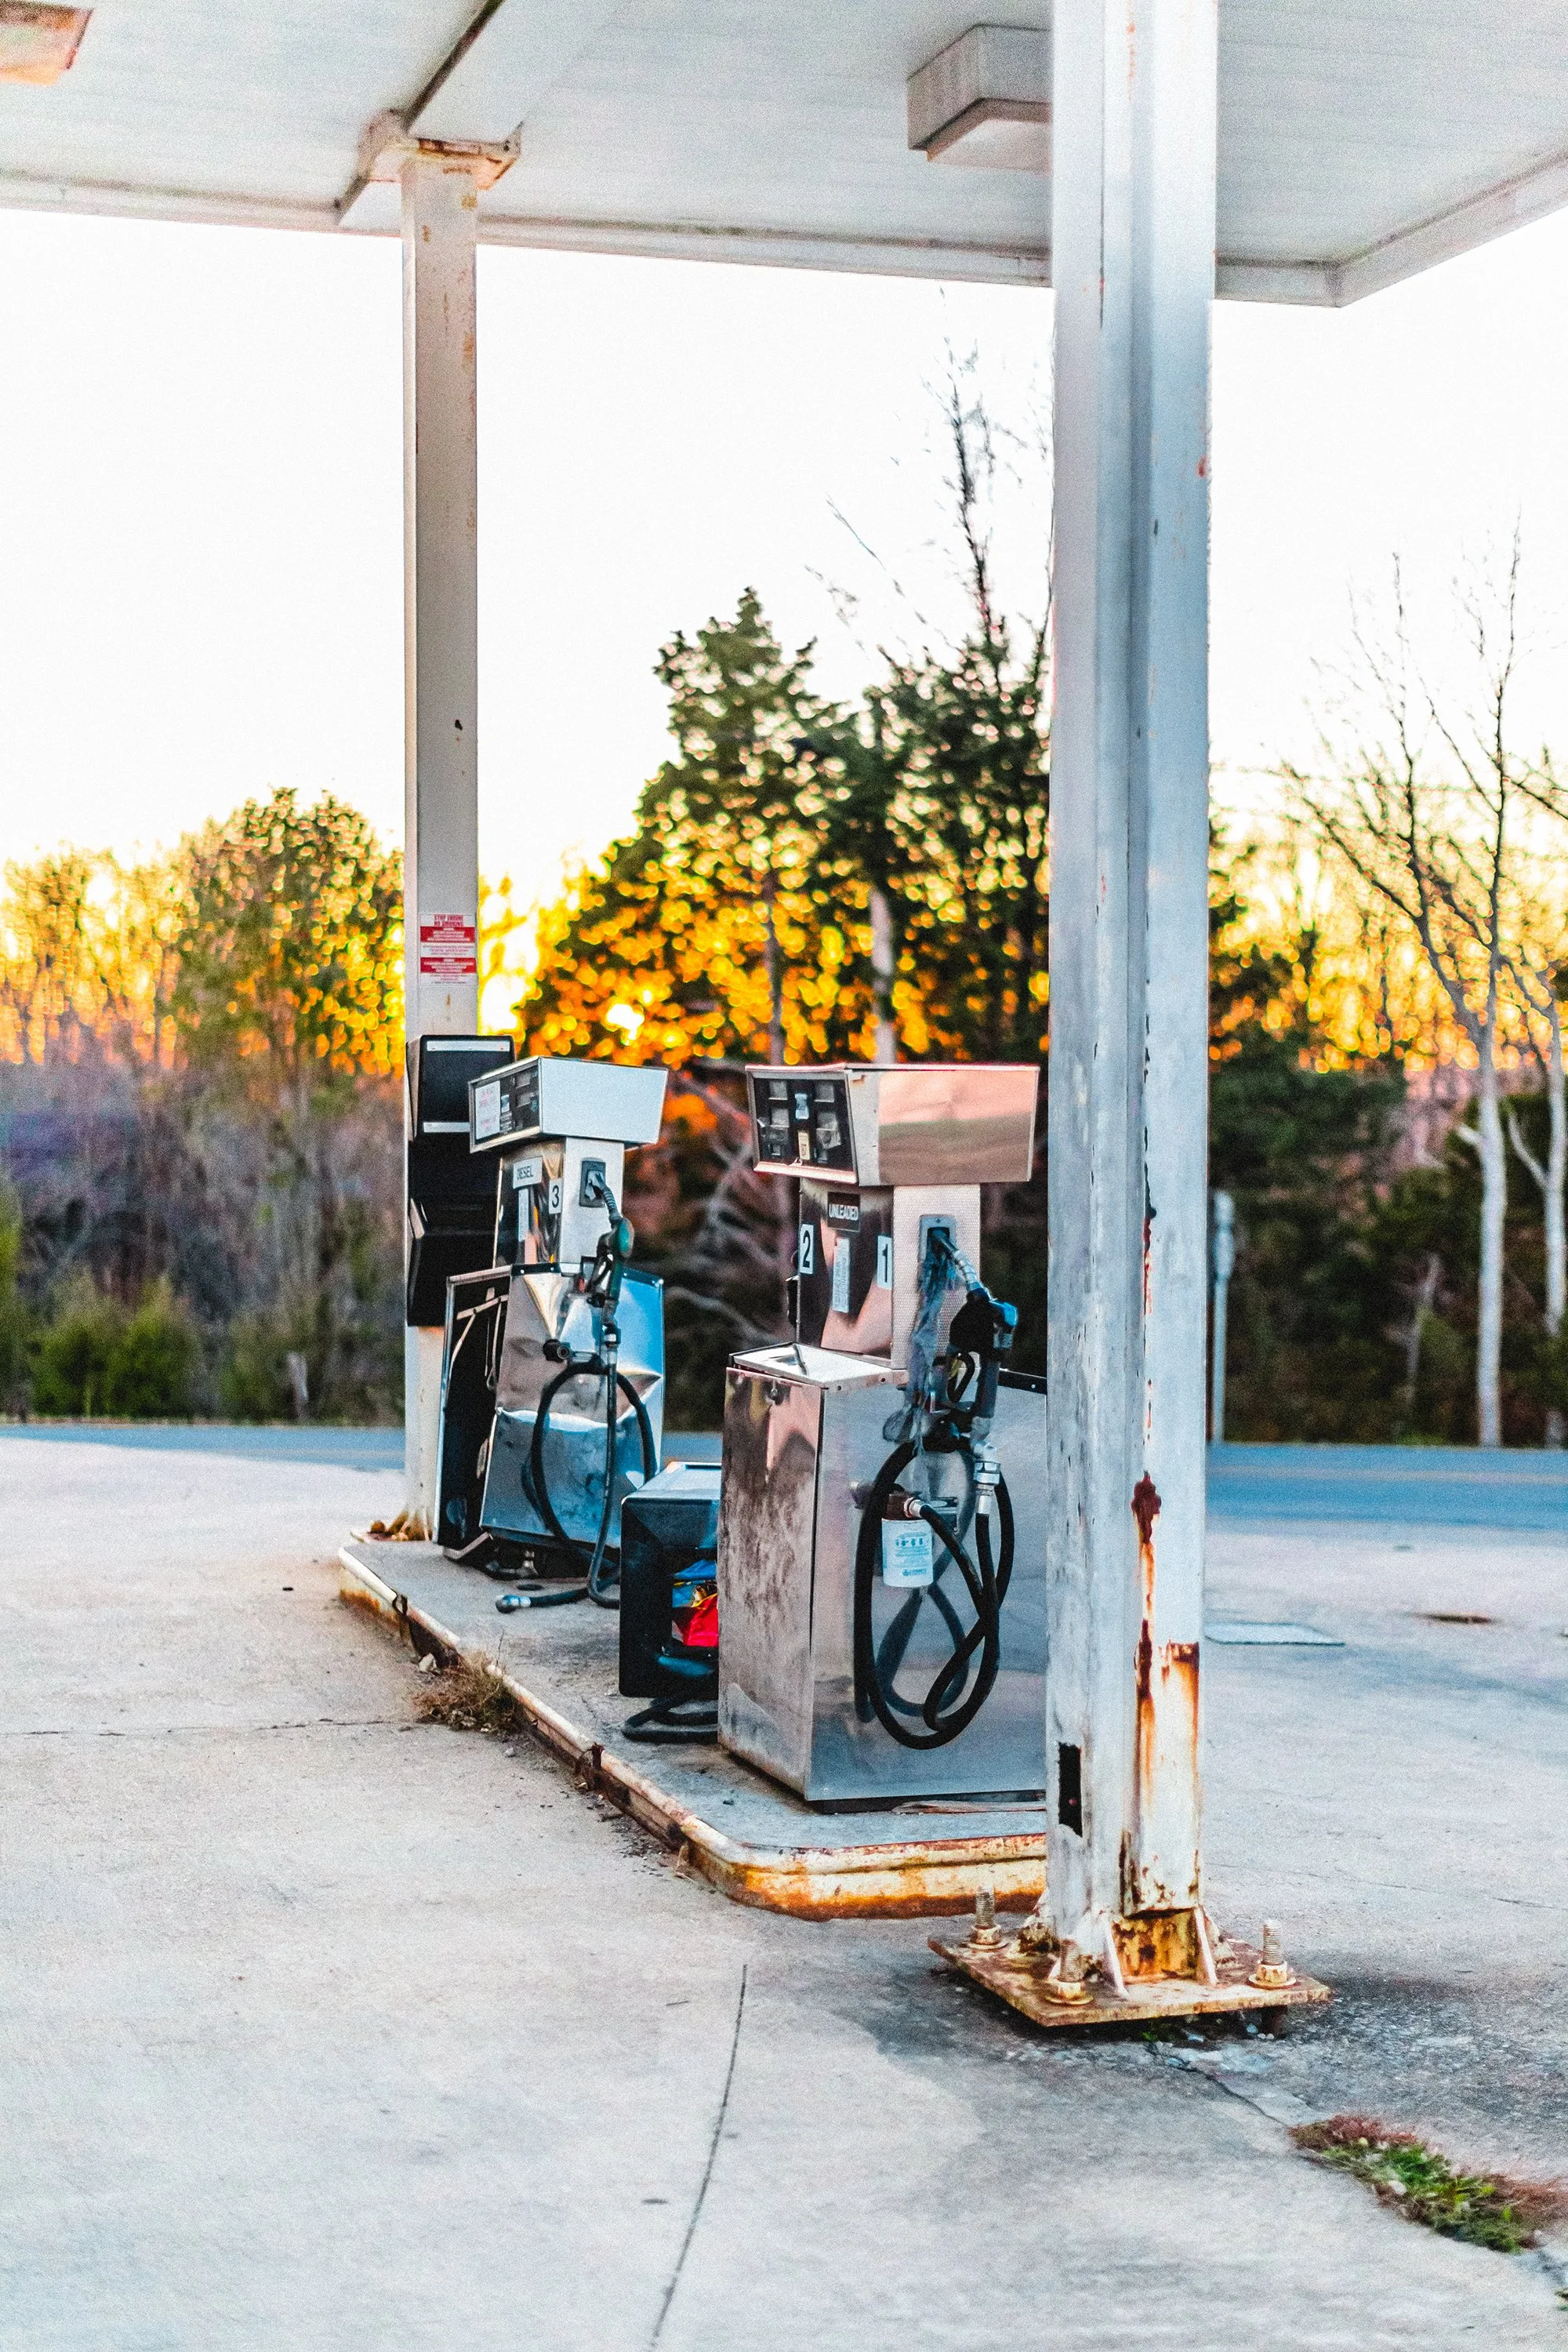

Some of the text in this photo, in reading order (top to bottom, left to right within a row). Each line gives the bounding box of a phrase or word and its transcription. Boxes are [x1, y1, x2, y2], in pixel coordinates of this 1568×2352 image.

[517, 1166, 533, 1179] DIESEL
[552, 1185, 560, 1208] 3
[829, 1203, 858, 1221] UNLEADED
[803, 1230, 811, 1269] 2
[882, 1243, 888, 1283] 1
